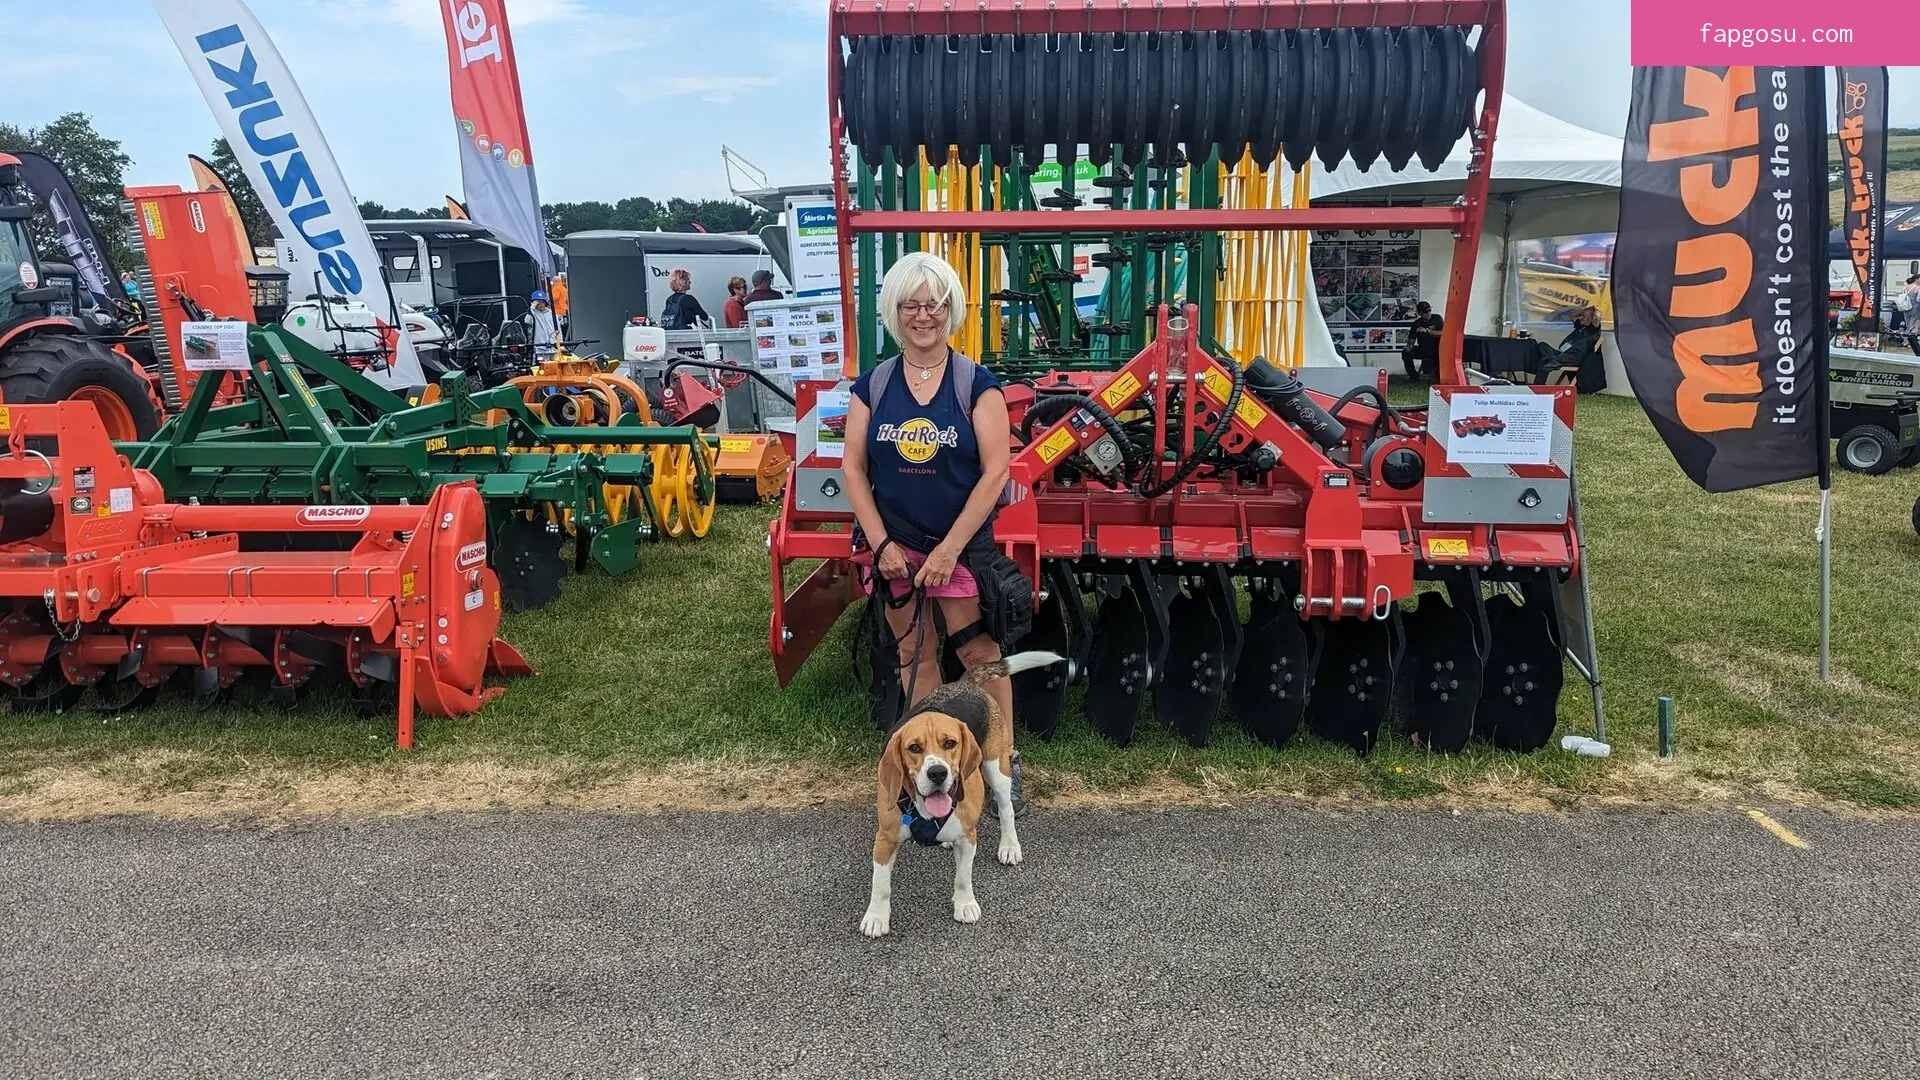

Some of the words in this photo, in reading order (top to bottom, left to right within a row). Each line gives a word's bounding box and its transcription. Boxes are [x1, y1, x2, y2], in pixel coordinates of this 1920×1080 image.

[1771, 66, 1788, 111] ea
[1770, 122, 1790, 179] the
[1773, 189, 1793, 263] cost
[1647, 66, 1763, 432] muck
[1538, 287, 1589, 307] KOMATSU
[1768, 273, 1795, 395] doesn't
[1841, 376, 1912, 387] WHEELBARROW
[1855, 371, 1899, 380] ELECTRIC
[1772, 403, 1796, 424] it
[876, 423, 919, 443] Hard
[919, 426, 958, 448] Rock
[907, 447, 927, 455] CAFE
[898, 467, 936, 475] BARCELONA
[307, 507, 365, 517] MASCHIO
[461, 545, 486, 561] MASCHIO
